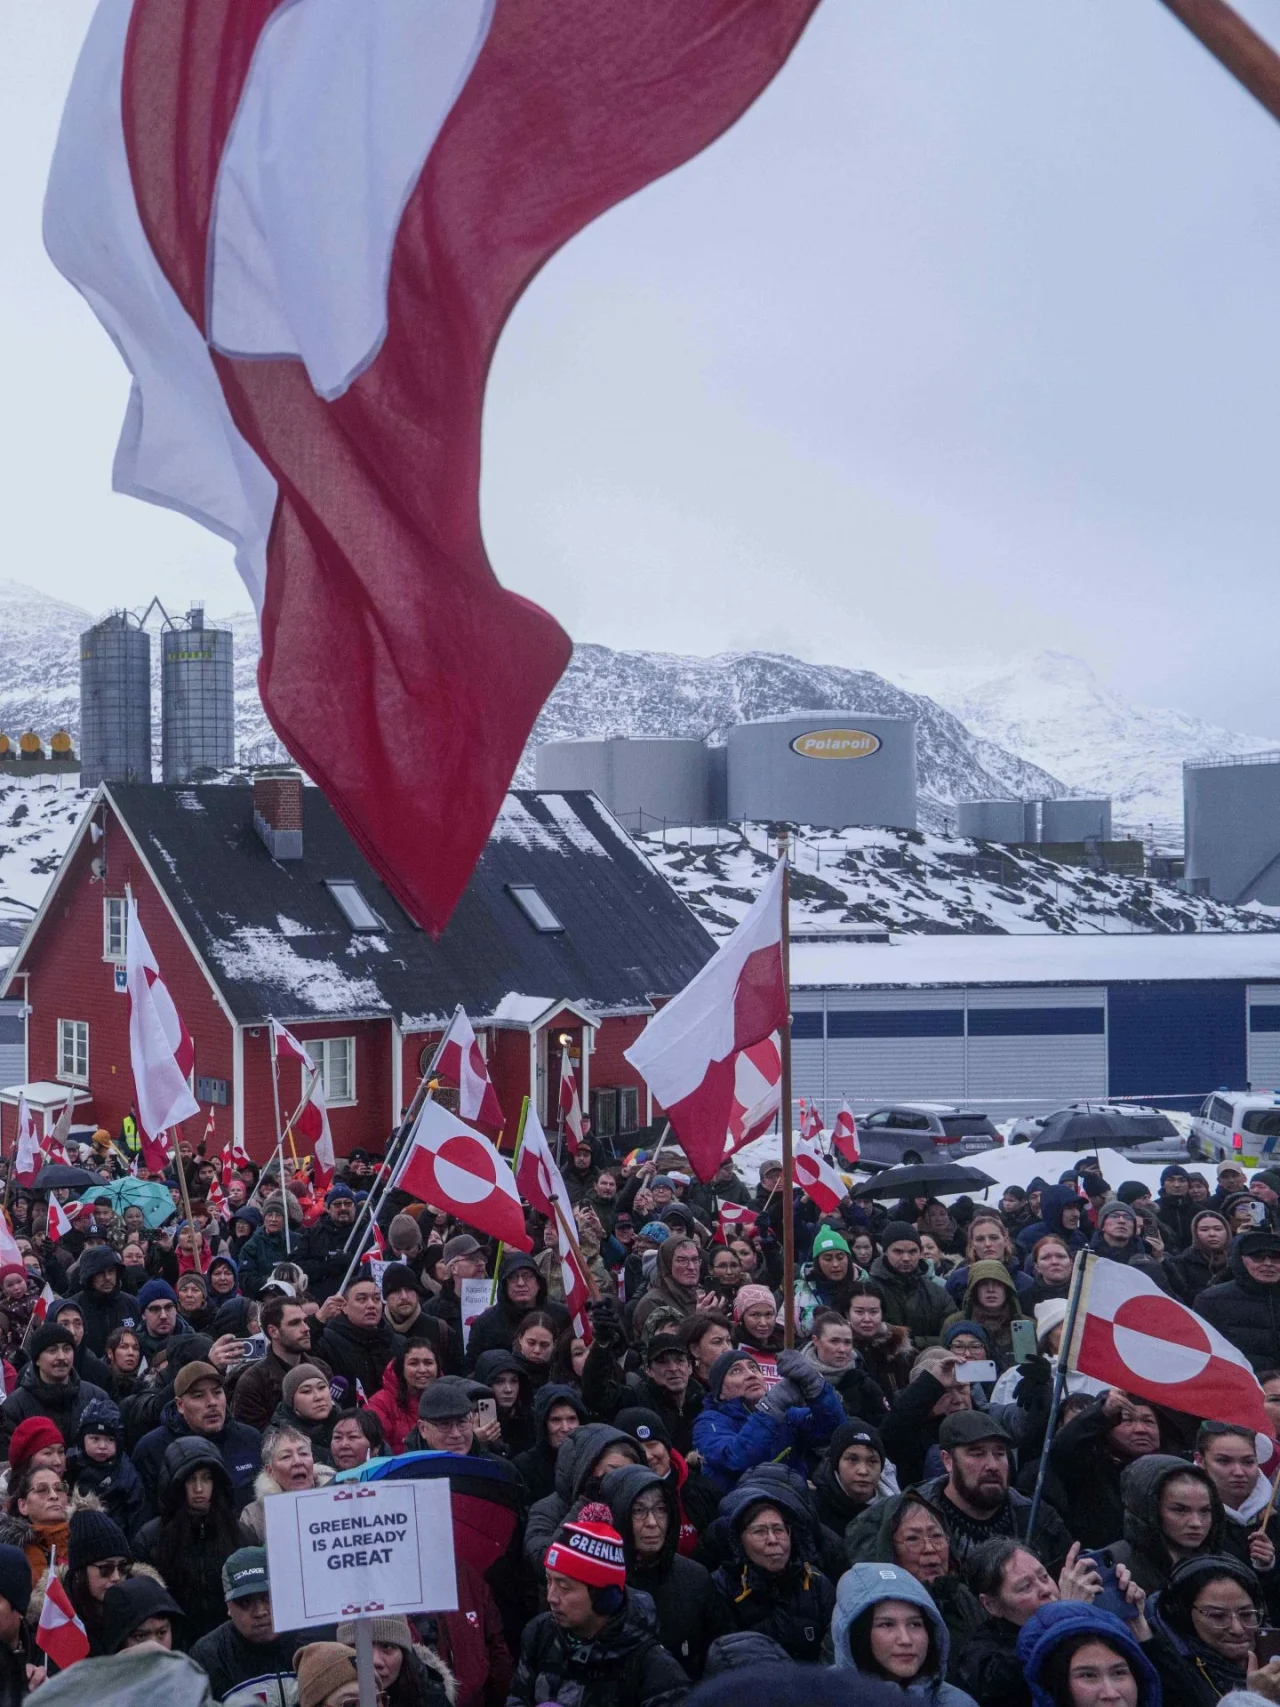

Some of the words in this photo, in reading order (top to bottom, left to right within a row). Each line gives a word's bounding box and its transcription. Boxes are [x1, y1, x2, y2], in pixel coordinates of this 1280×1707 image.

[804, 738, 871, 750] Polaroil
[309, 1513, 408, 1535] GREENLAND
[312, 1539, 327, 1552] IS
[331, 1530, 407, 1549] ALREADY
[327, 1548, 393, 1570] GREAT
